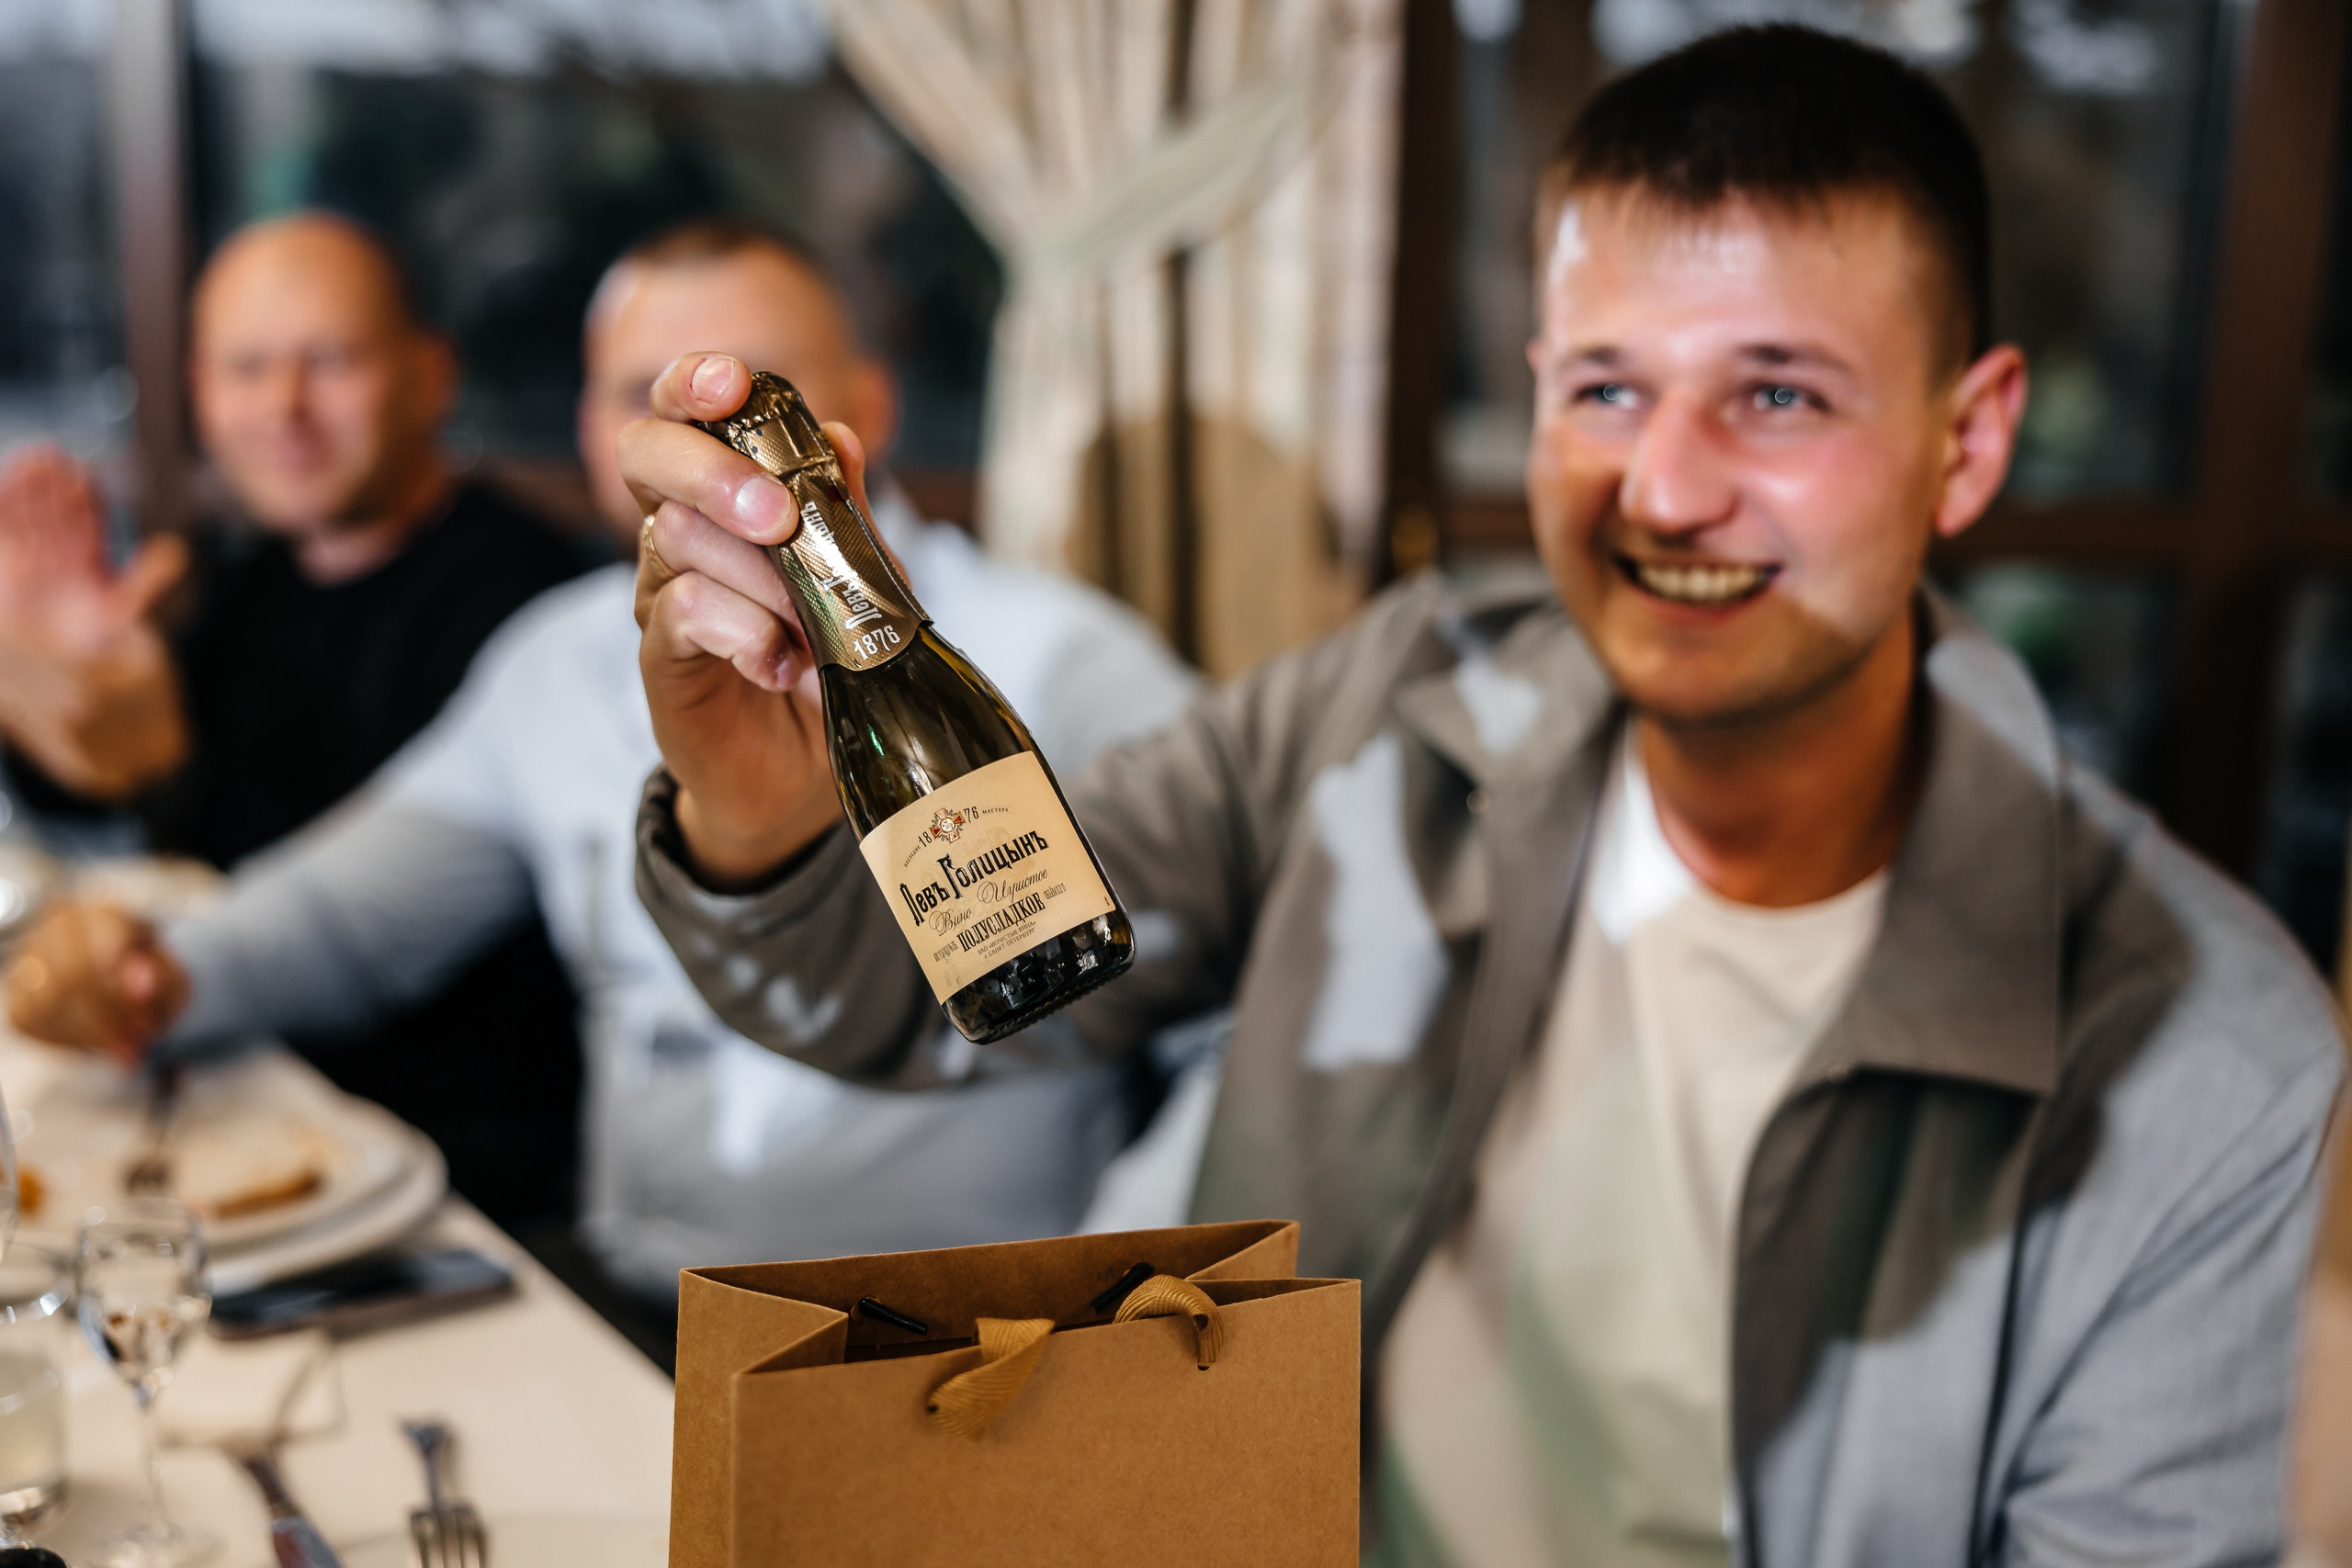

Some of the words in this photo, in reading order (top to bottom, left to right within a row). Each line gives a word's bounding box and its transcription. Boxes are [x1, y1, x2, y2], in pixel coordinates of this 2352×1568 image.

[842, 577, 882, 630] Левъ
[854, 625, 900, 660] 1876
[918, 831, 933, 847] 18
[963, 806, 979, 823] 76
[899, 882, 951, 927] Левъ
[936, 830, 1049, 899] Голицынъ
[929, 908, 972, 936] Вино
[977, 869, 1048, 904] Игристое
[956, 892, 1046, 953] ПОЛУСЛАДКОЕ
[977, 947, 989, 955] ЗАО
